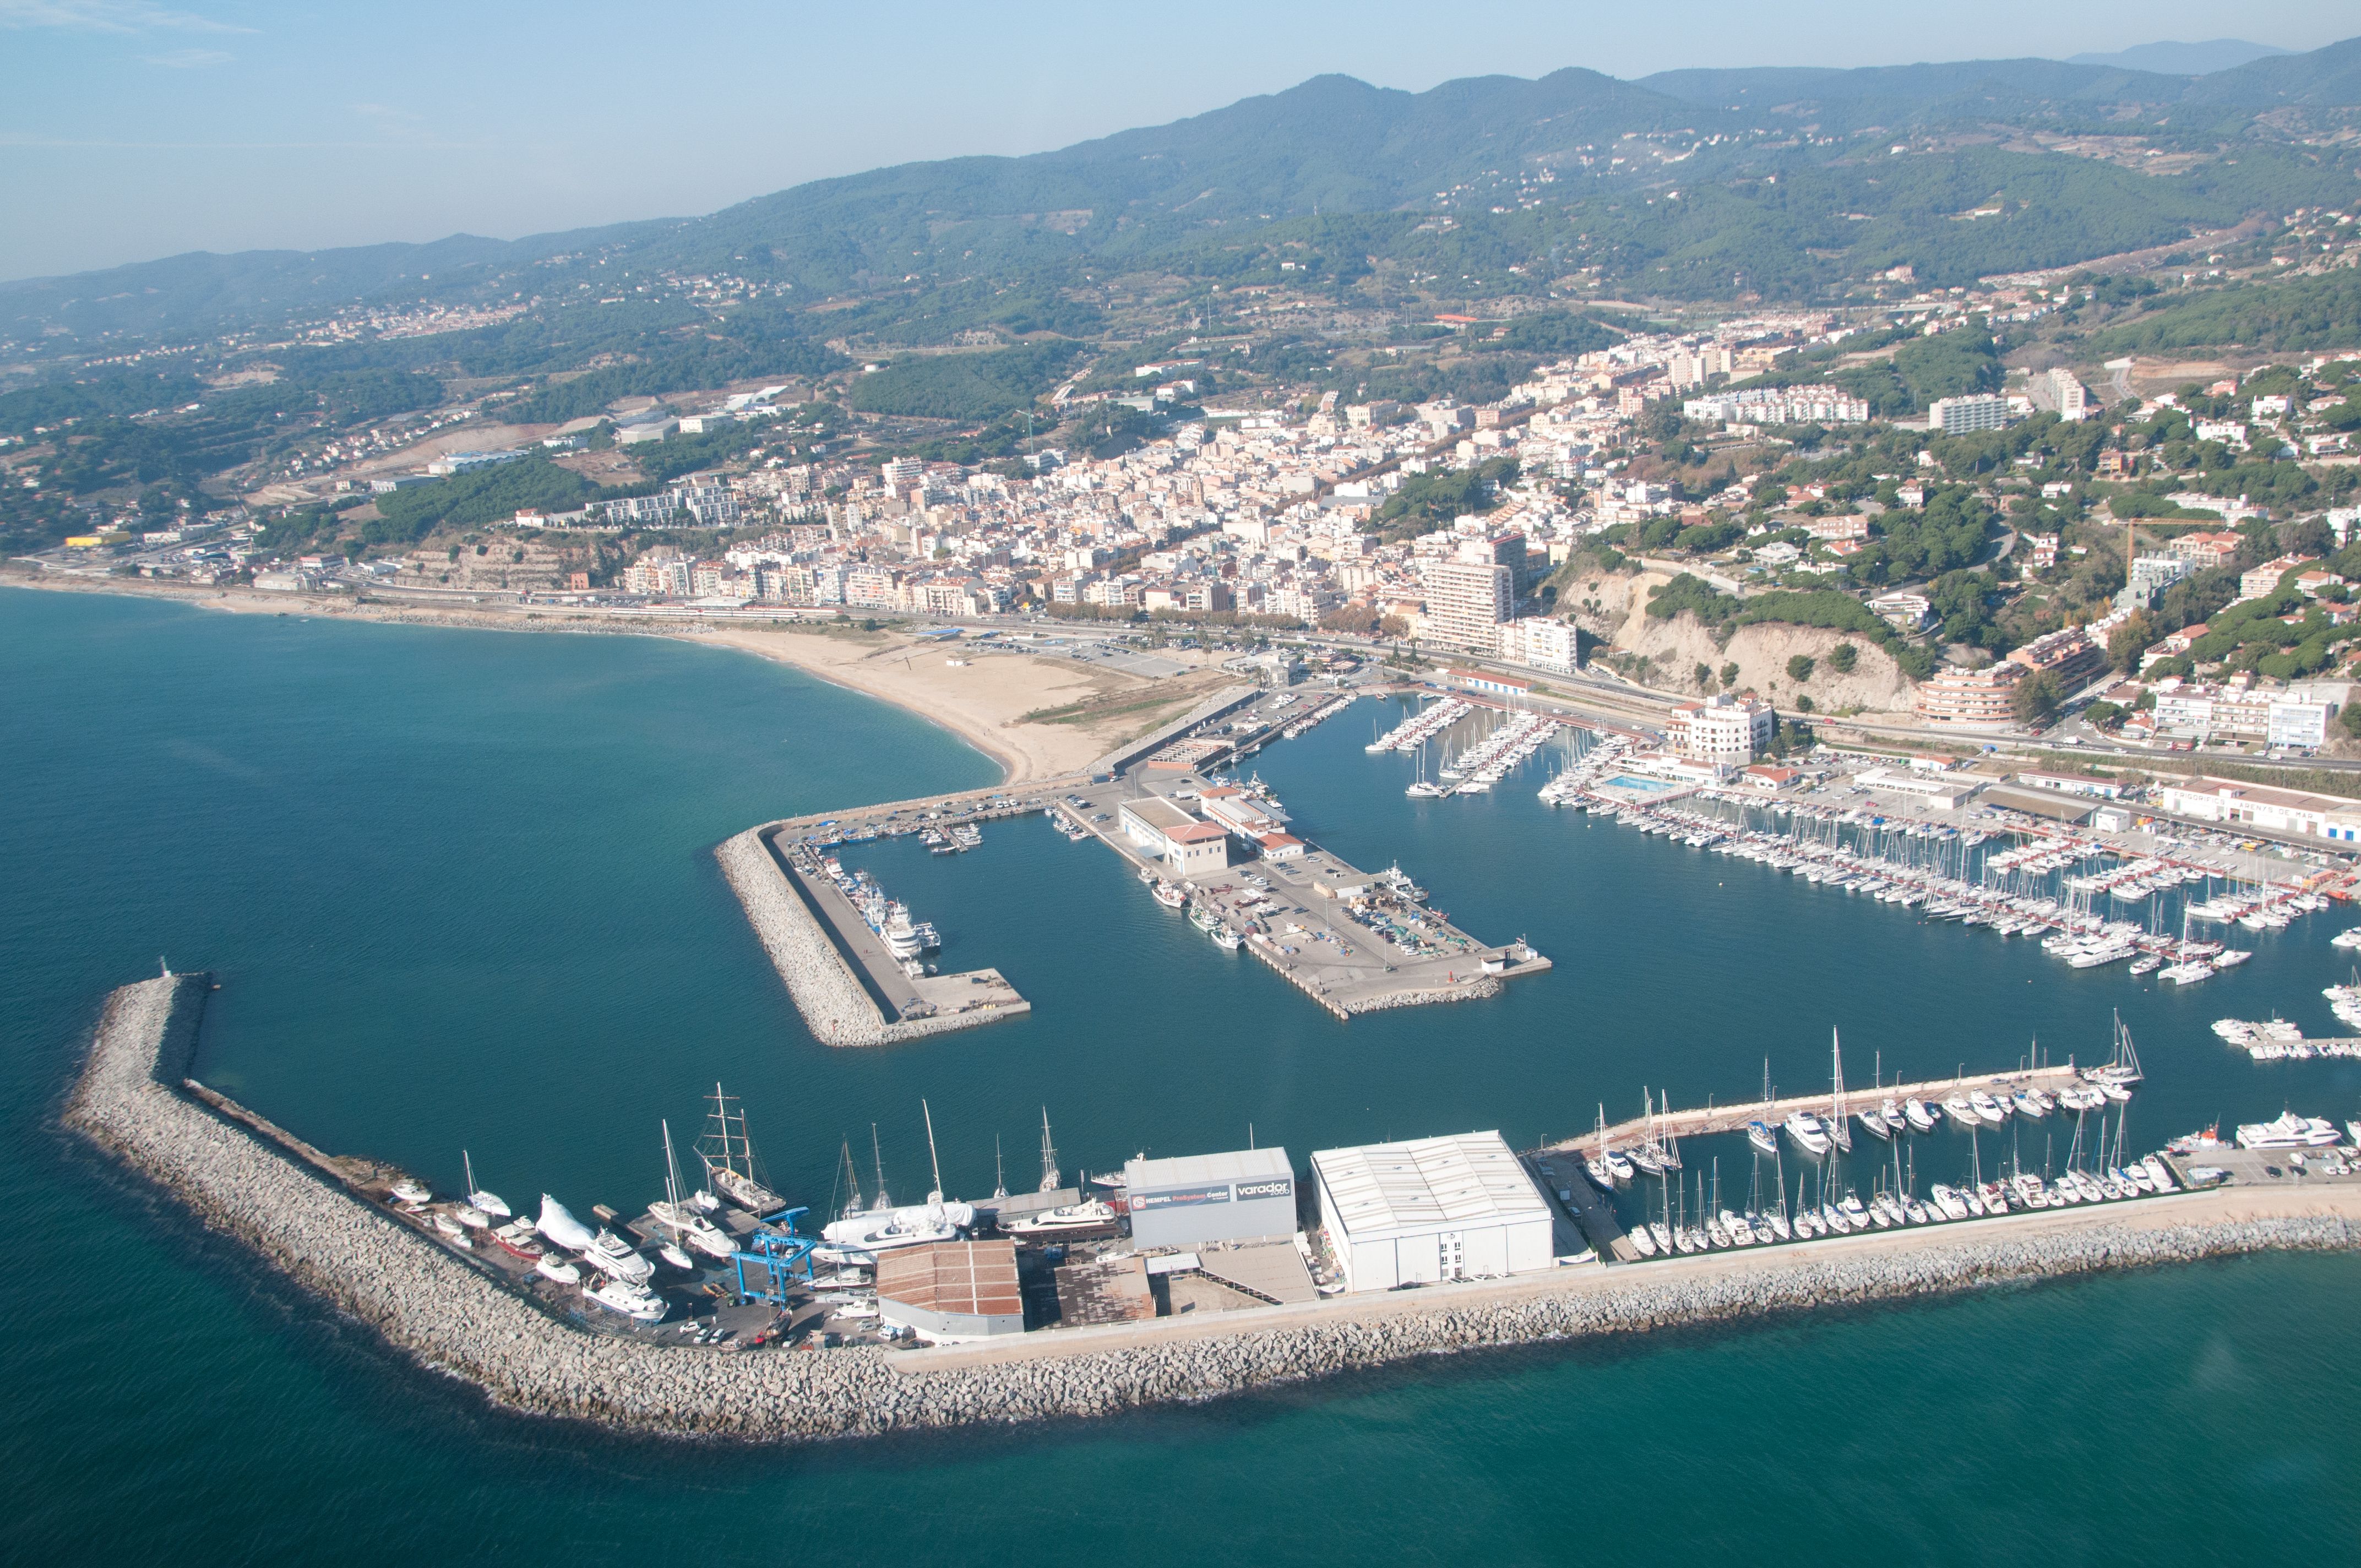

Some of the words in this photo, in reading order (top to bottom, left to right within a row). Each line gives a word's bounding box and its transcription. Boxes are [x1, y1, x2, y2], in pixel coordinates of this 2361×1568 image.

[2174, 792, 2225, 805] FRIGORIFICS
[2239, 803, 2273, 813] ARENYS
[1238, 1183, 1287, 1195] varador
